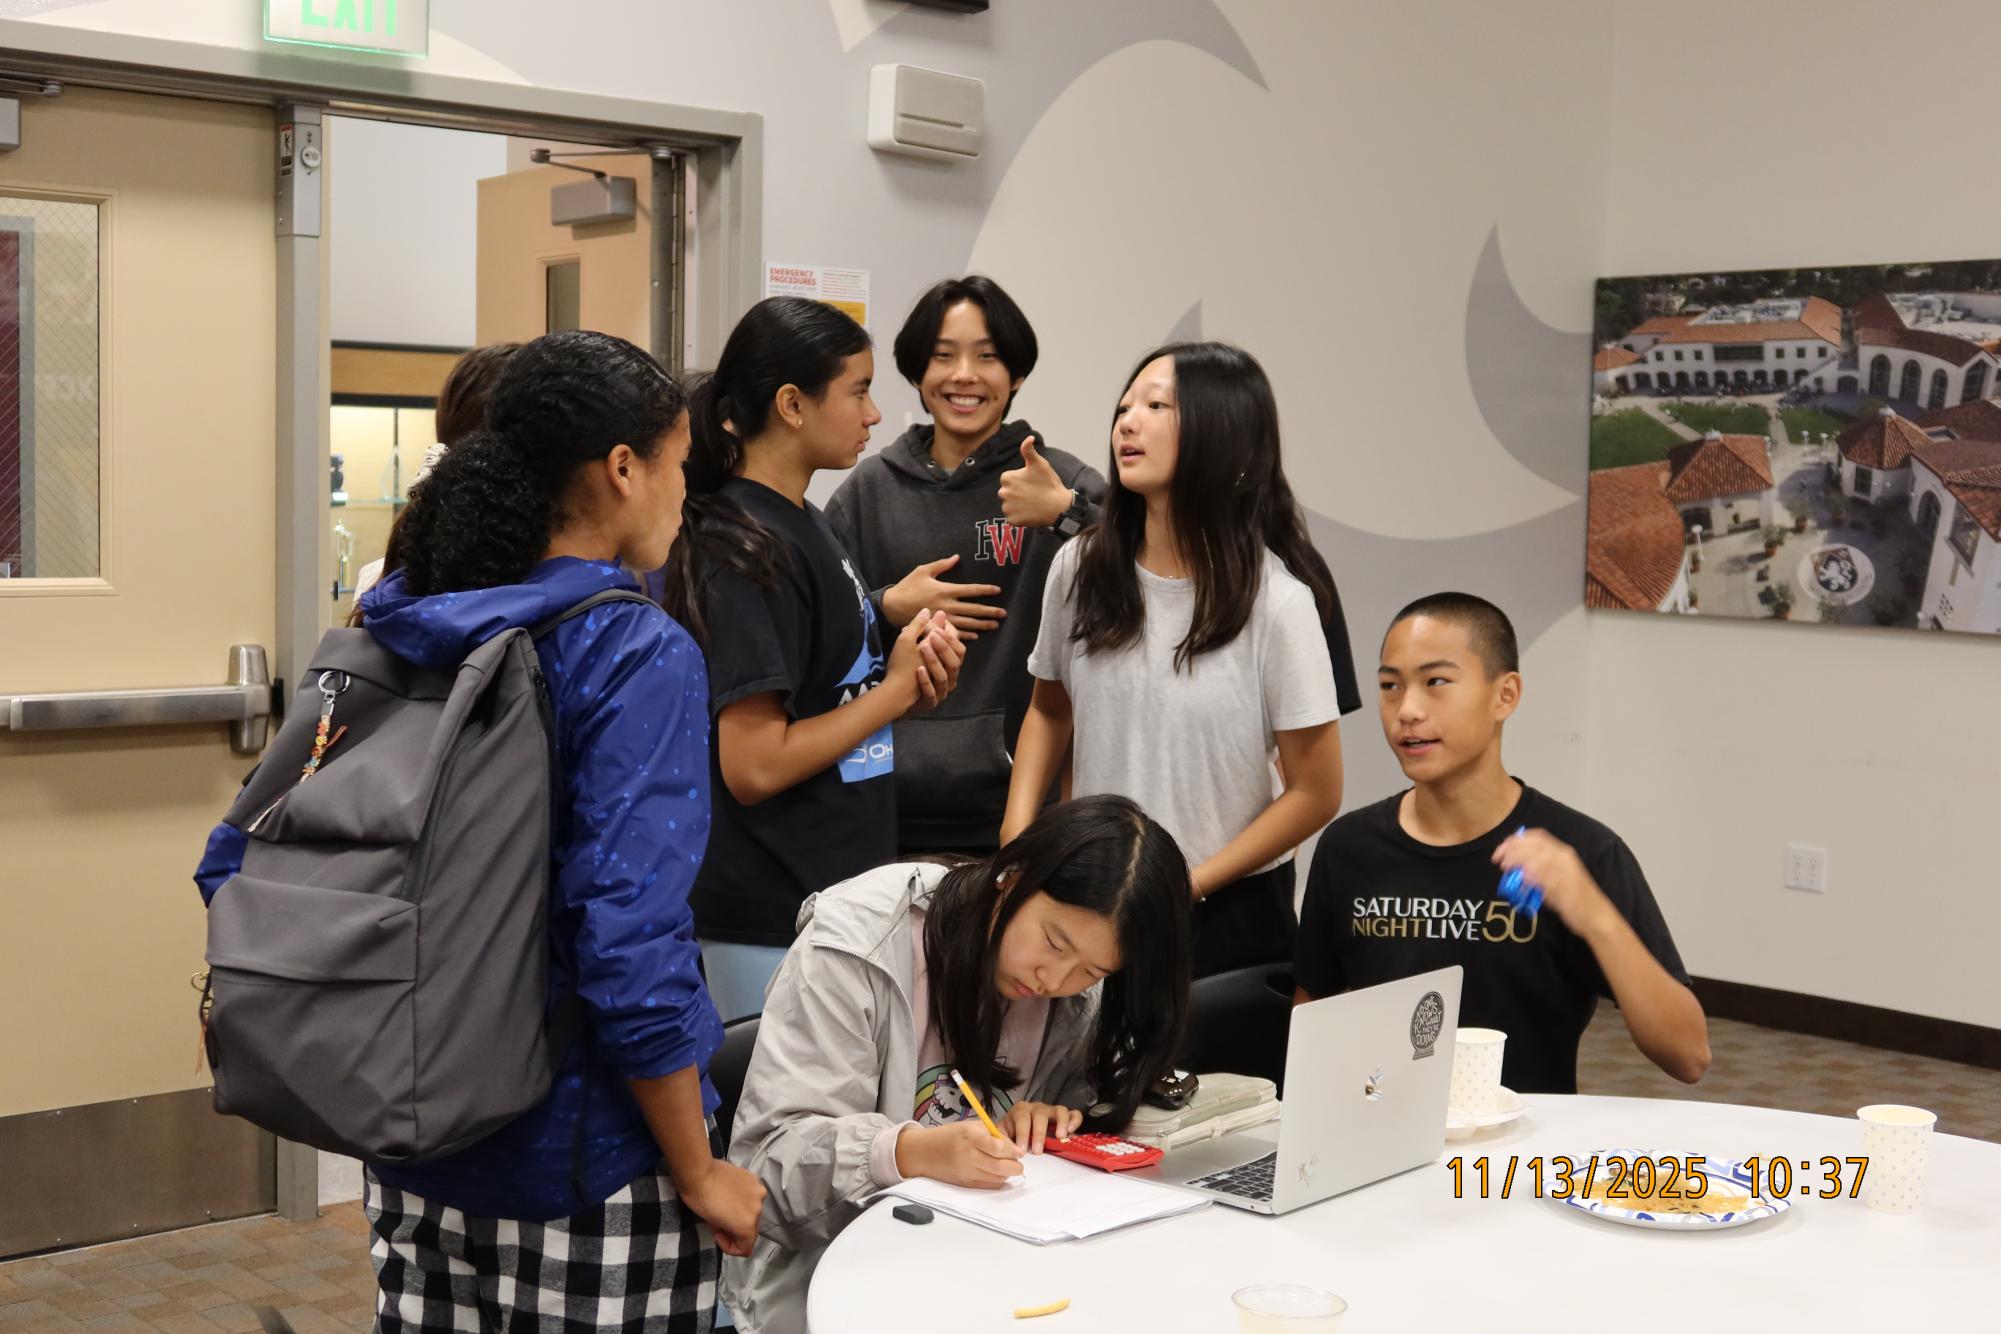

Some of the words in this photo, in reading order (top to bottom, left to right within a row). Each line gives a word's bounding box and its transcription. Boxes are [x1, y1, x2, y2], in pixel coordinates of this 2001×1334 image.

[770, 268, 813, 277] EMERGENCY
[769, 275, 817, 286] PROCEDURES
[1352, 897, 1484, 920] SATURDAY
[1482, 901, 1538, 944] 50
[1416, 1031, 1436, 1046] DOING
